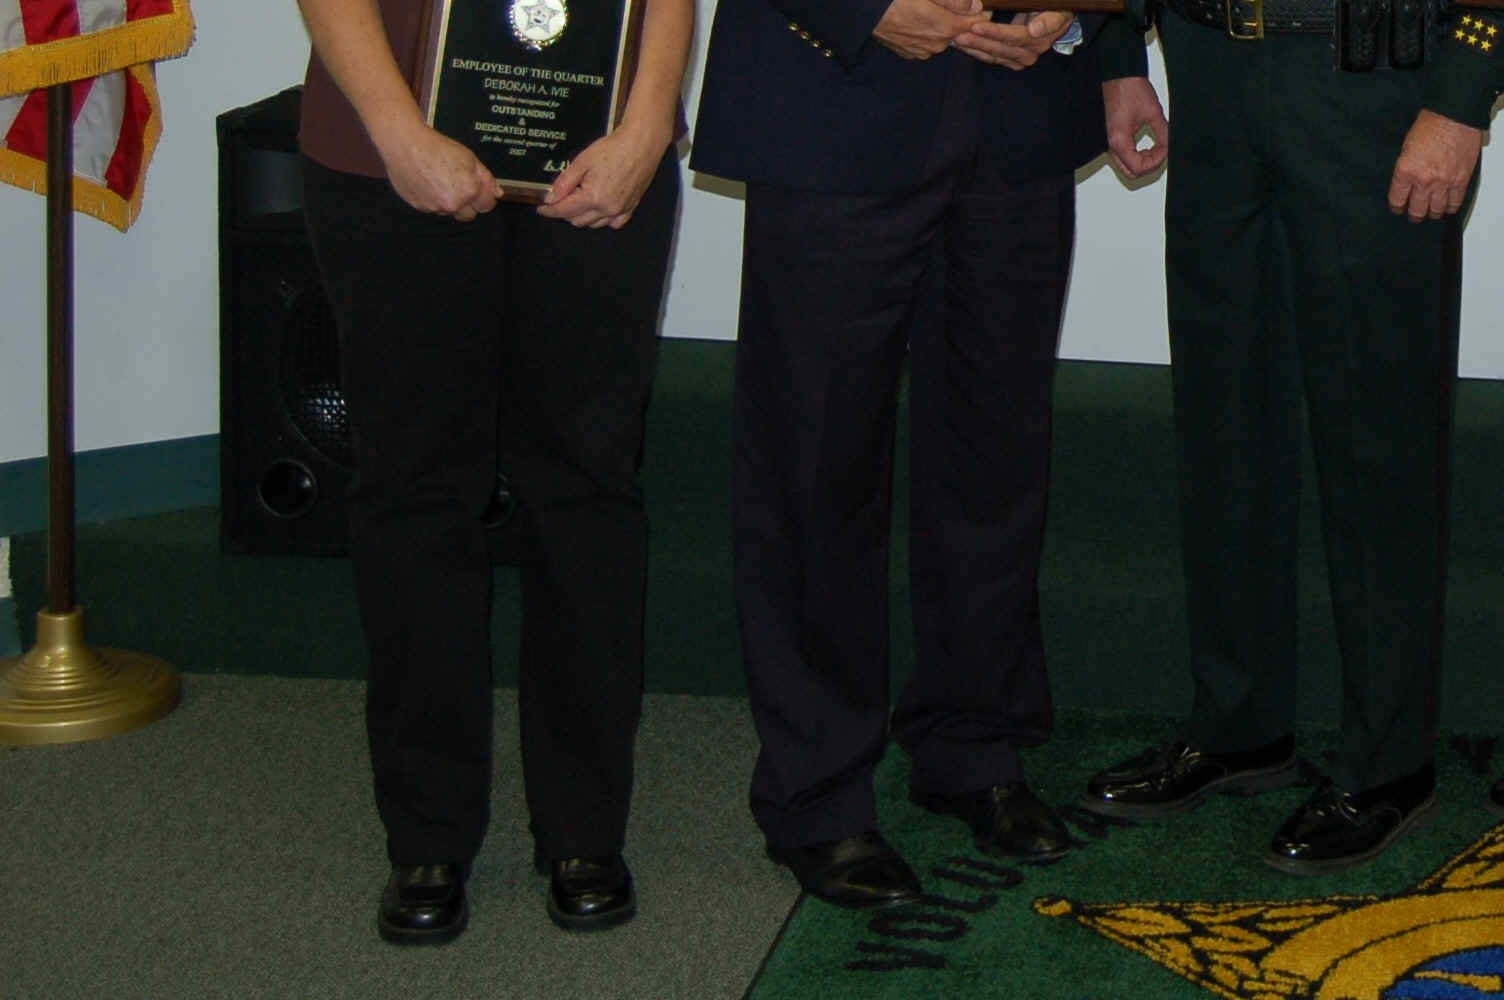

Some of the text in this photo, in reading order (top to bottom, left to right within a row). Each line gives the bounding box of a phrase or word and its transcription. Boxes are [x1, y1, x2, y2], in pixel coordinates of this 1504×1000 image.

[452, 58, 604, 86] EMPLOYEE OF THE QUARTER
[484, 78, 536, 93] DEBORAH
[491, 105, 556, 119] OUTSTANDING
[474, 122, 567, 140] DEDICATED SERVICE
